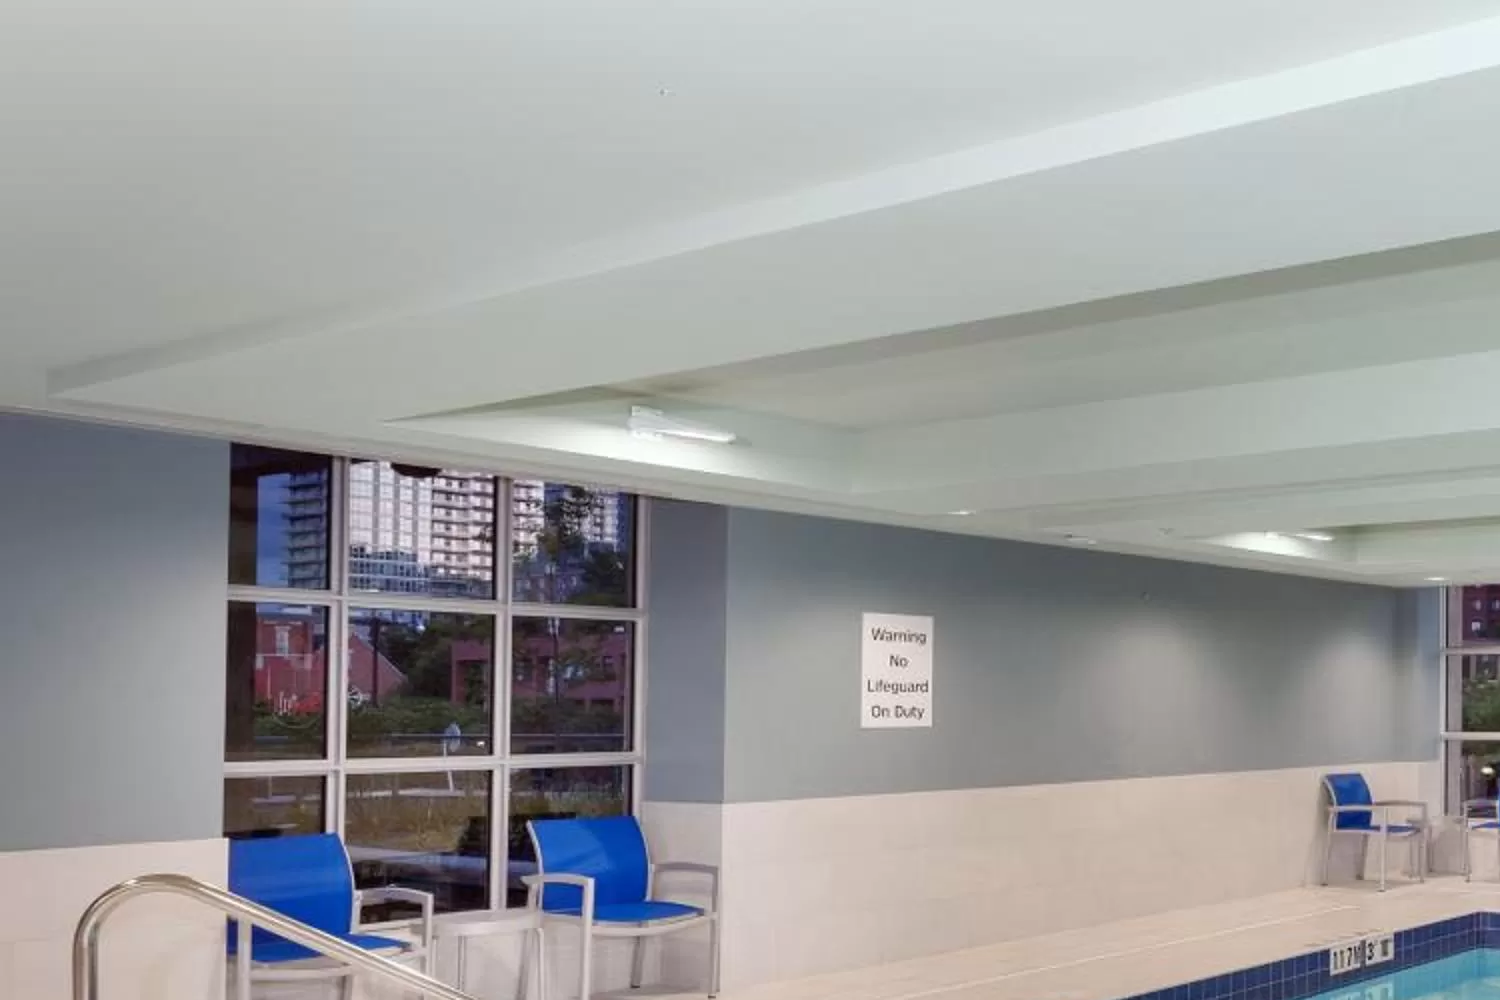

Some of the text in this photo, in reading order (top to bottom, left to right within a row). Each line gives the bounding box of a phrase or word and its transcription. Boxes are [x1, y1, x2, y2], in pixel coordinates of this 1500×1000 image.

[871, 627, 927, 645] Warning
[889, 655, 909, 668] No
[867, 679, 929, 694] Lifeguard
[871, 705, 925, 721] On Duty
